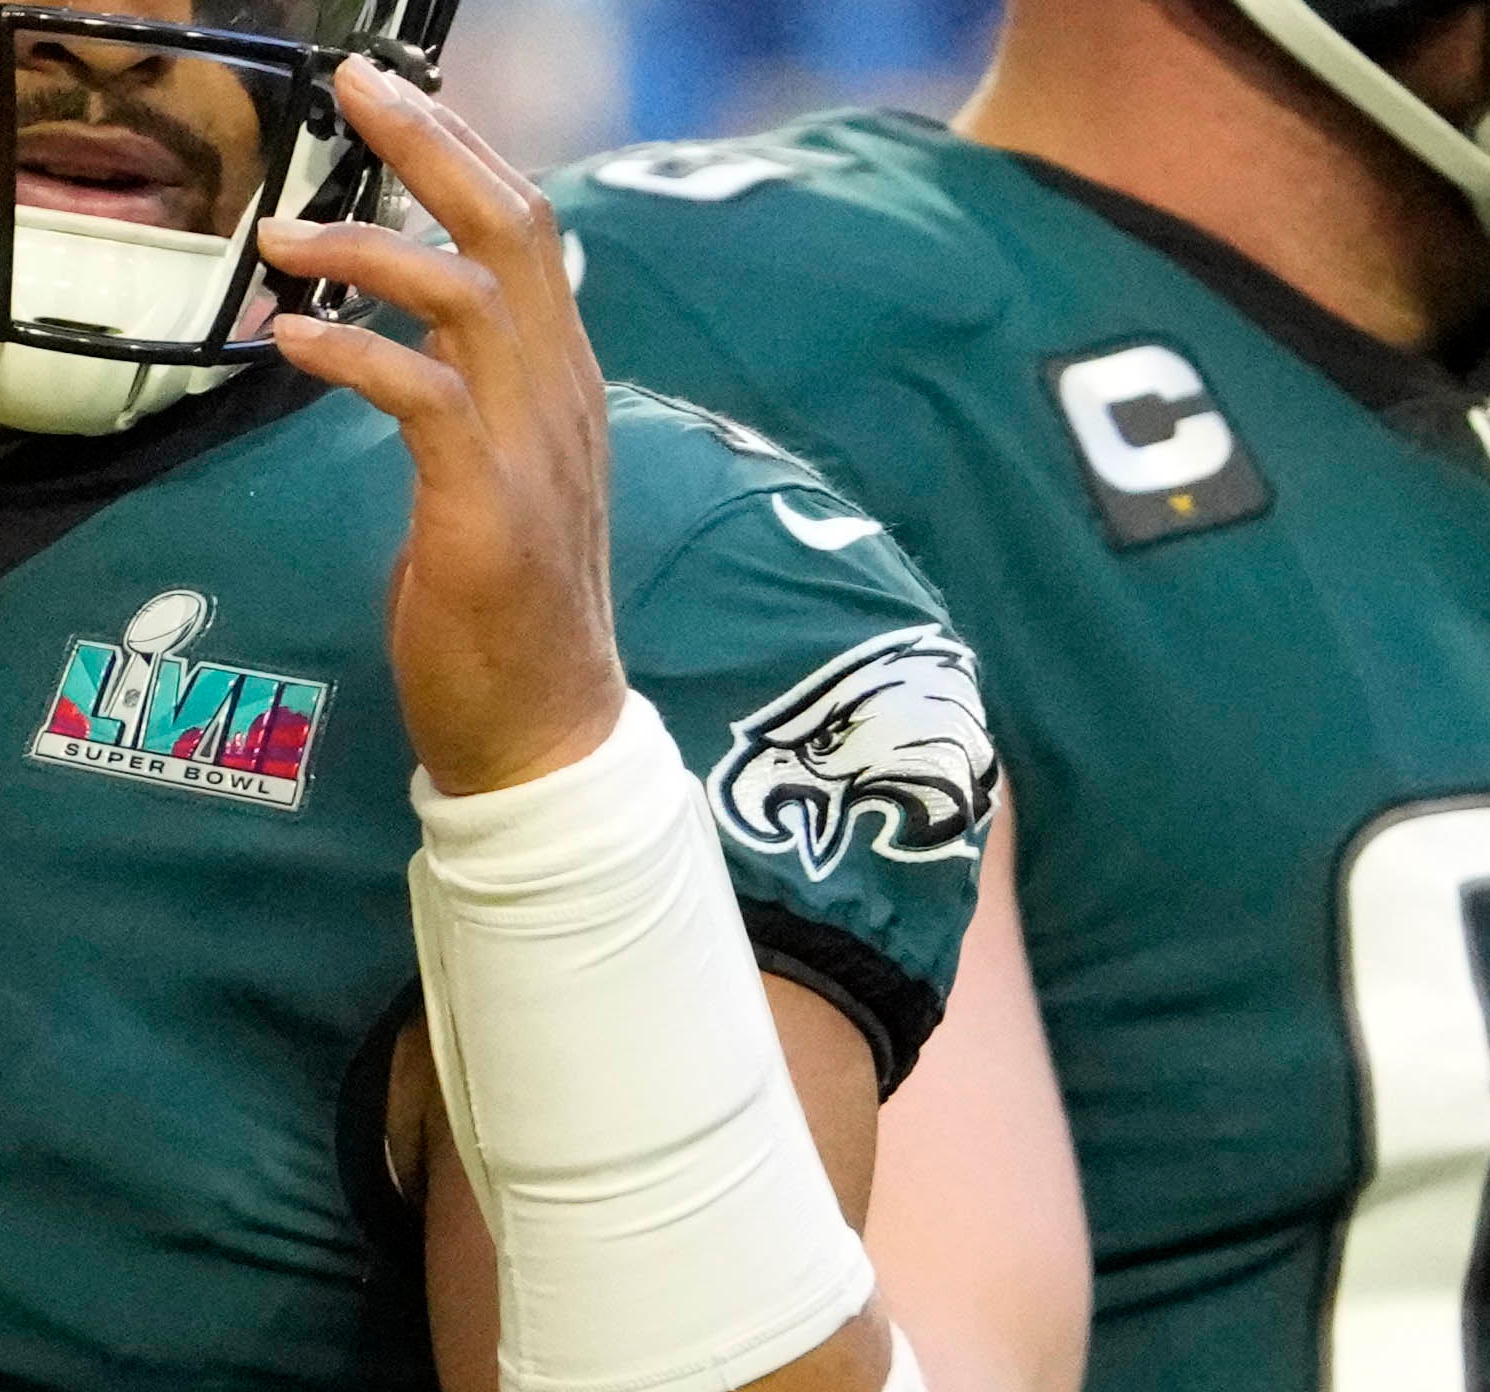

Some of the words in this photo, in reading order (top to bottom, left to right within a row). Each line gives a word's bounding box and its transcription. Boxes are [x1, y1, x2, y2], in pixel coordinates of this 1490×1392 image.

[1060, 343, 1235, 496] C
[63, 741, 166, 775] SUPER
[182, 765, 272, 796] BOWL
